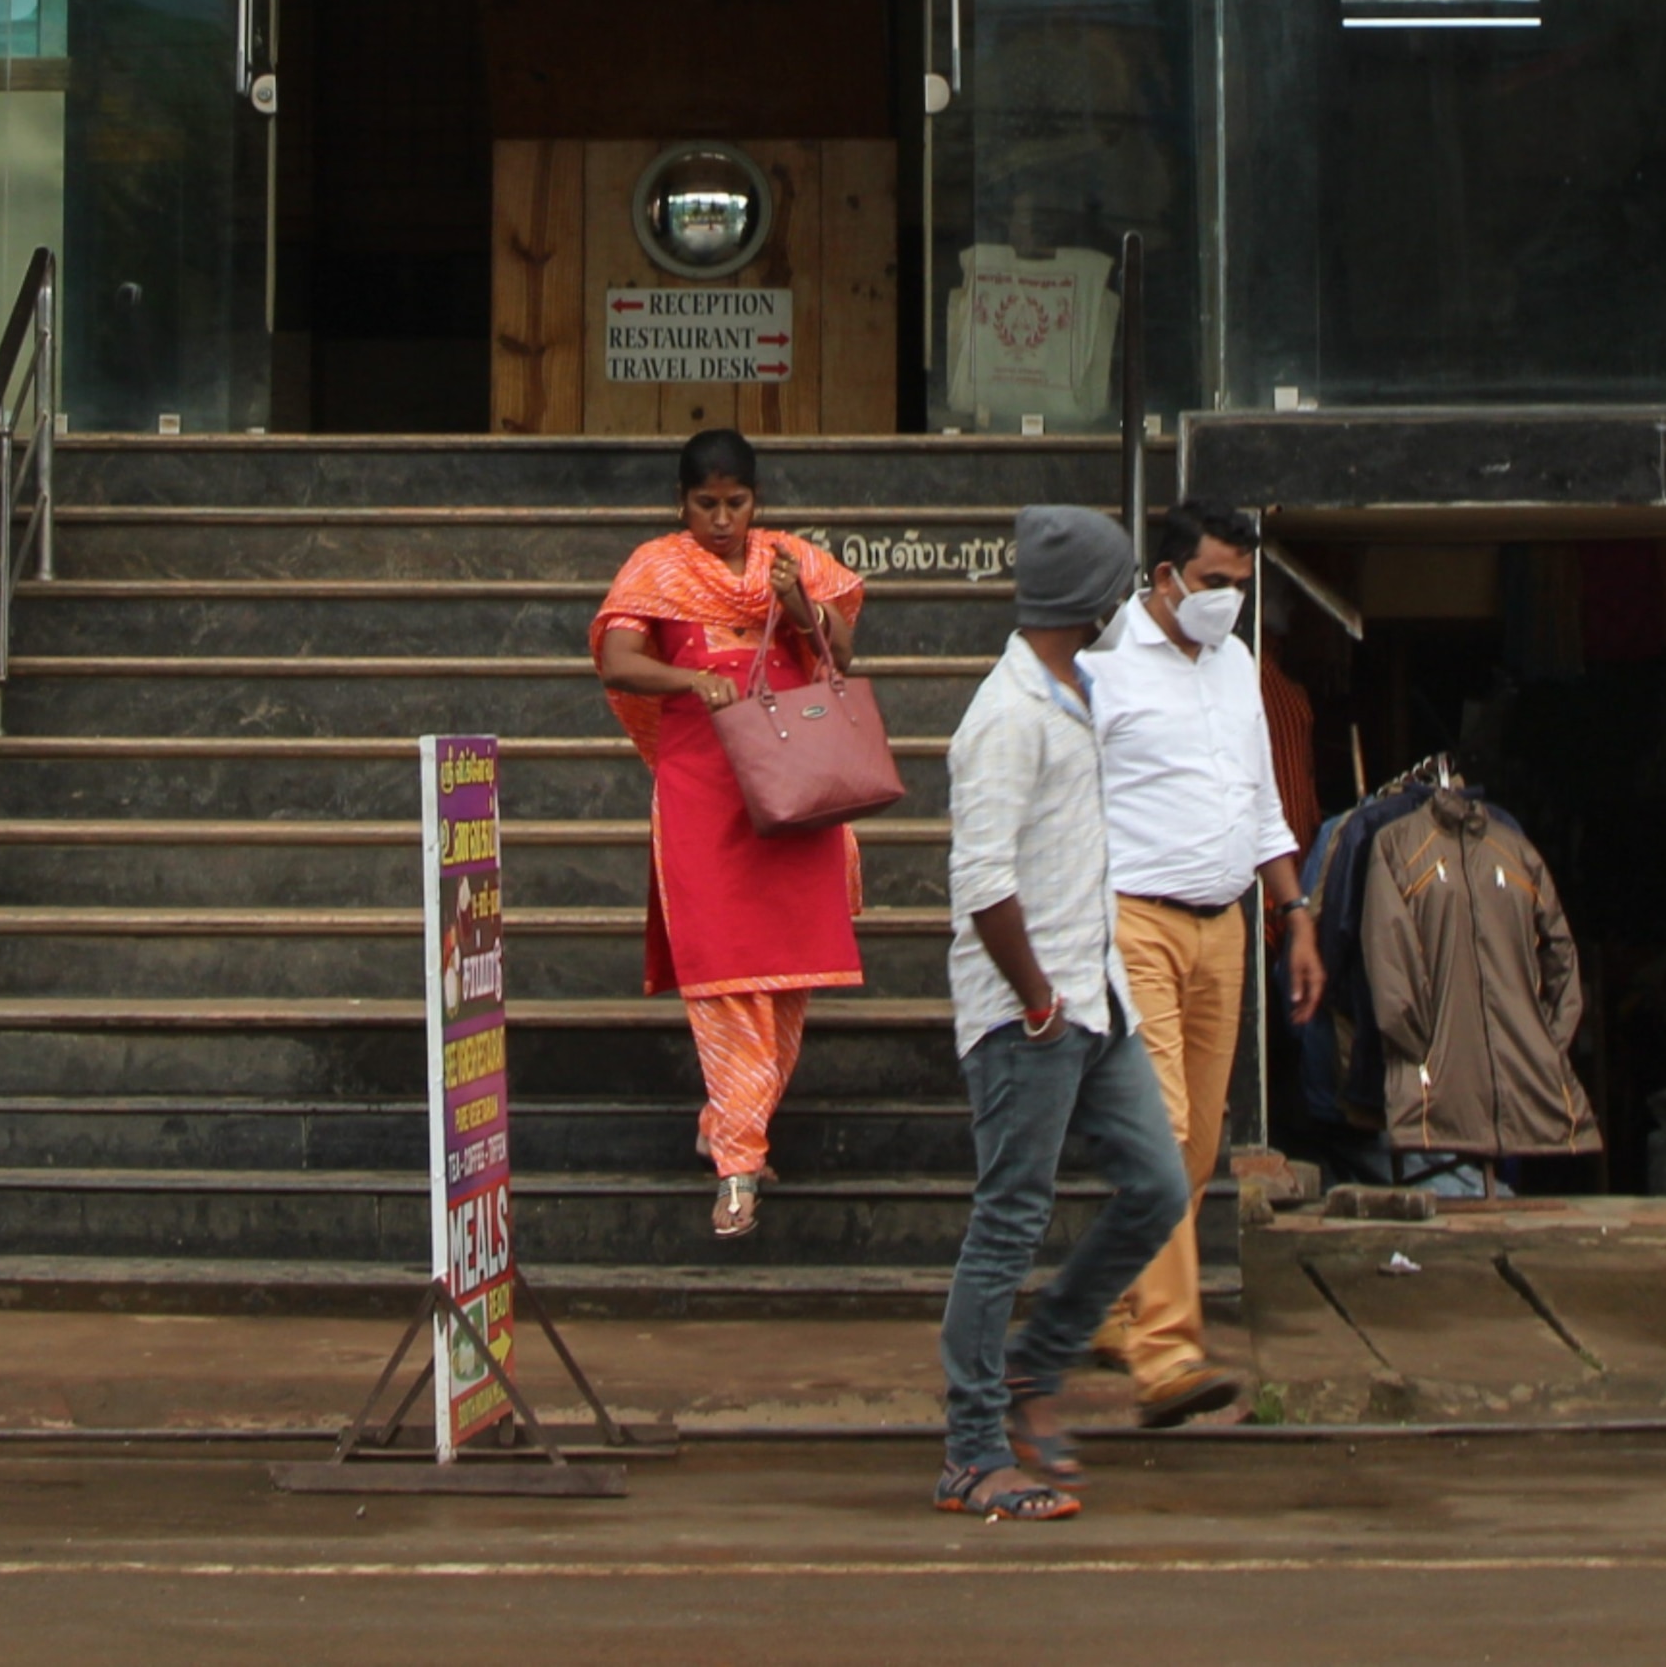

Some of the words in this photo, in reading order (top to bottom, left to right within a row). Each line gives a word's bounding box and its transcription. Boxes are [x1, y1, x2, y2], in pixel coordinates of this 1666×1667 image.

[649, 292, 775, 316] RECEPTION
[608, 326, 756, 350] RESTAURANT
[607, 356, 693, 379] TRAVEL
[699, 356, 759, 379] DESK
[448, 1183, 509, 1299] MEALS
